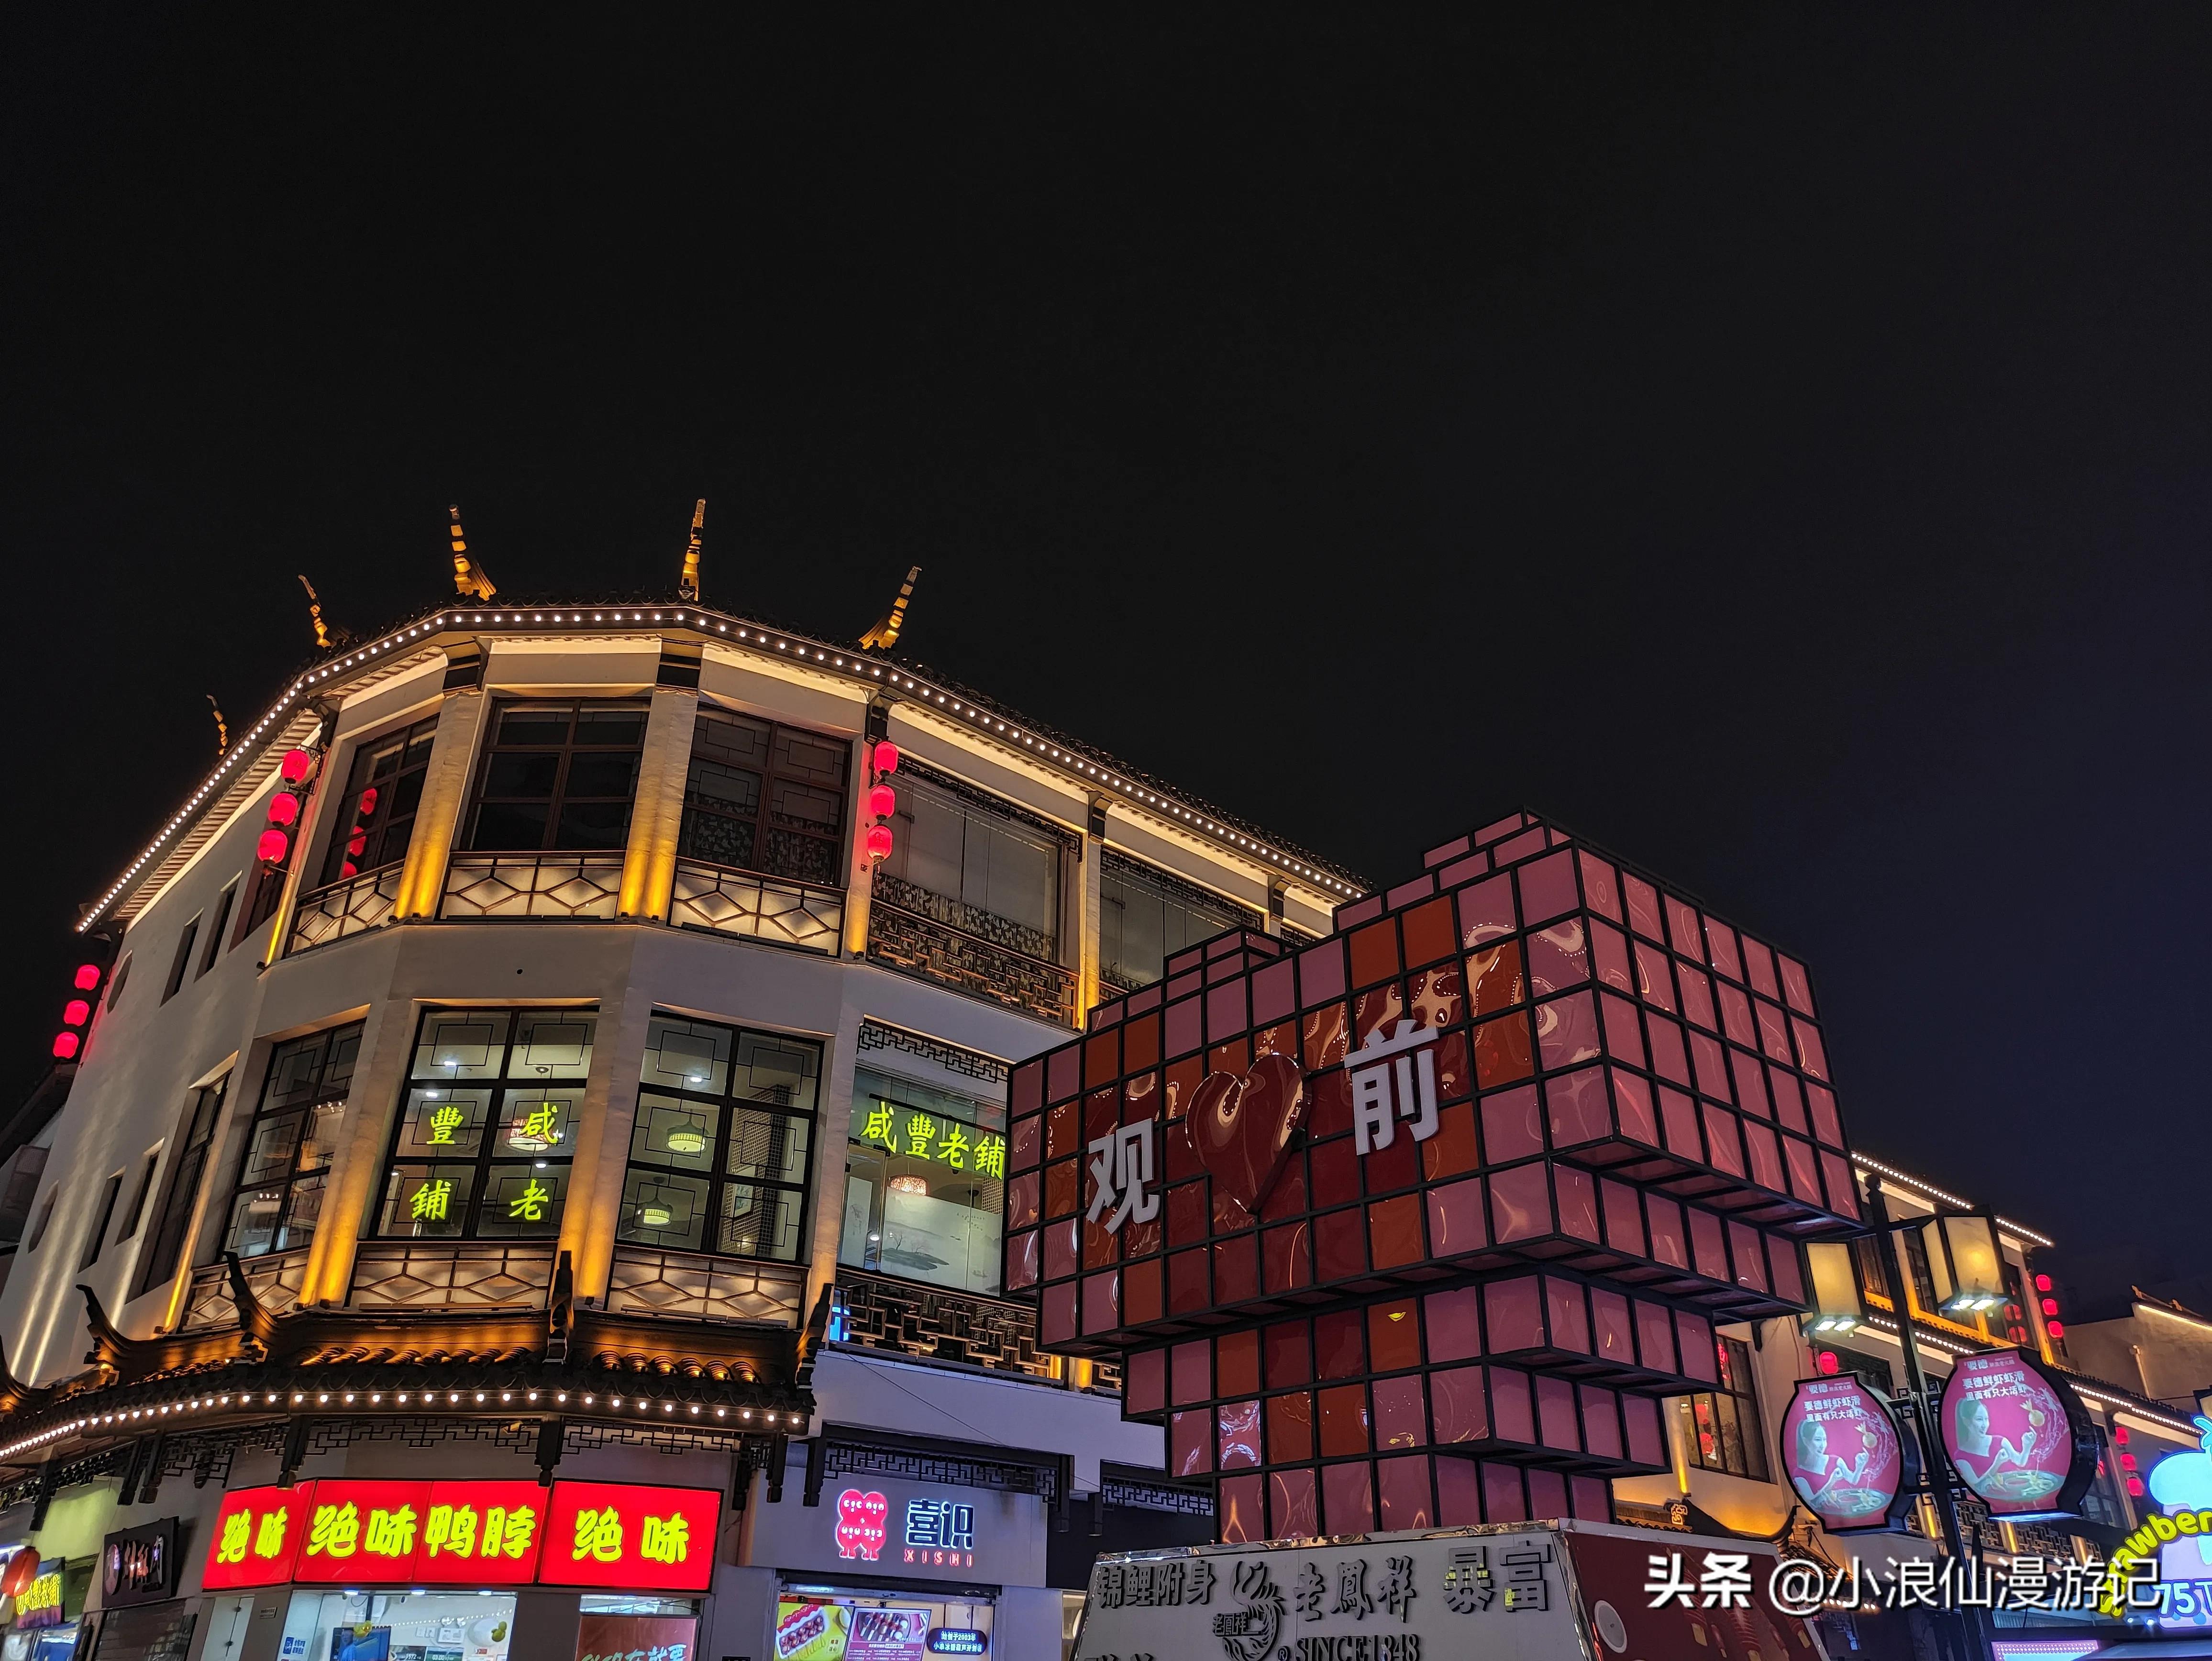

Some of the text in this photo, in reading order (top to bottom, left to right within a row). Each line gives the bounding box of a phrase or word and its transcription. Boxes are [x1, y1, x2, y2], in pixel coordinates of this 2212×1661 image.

[426, 1102, 560, 1145] 咸 豐
[1085, 1019, 1439, 1235] 观 前
[509, 1178, 548, 1221] 老
[216, 1506, 288, 1564] 绝味
[306, 1501, 537, 1560] 绝味鸭脖
[572, 1505, 690, 1564] 绝味
[905, 1498, 974, 1550] 喜识
[904, 1549, 974, 1567] XISHI
[1443, 1540, 1554, 1614] 暴富
